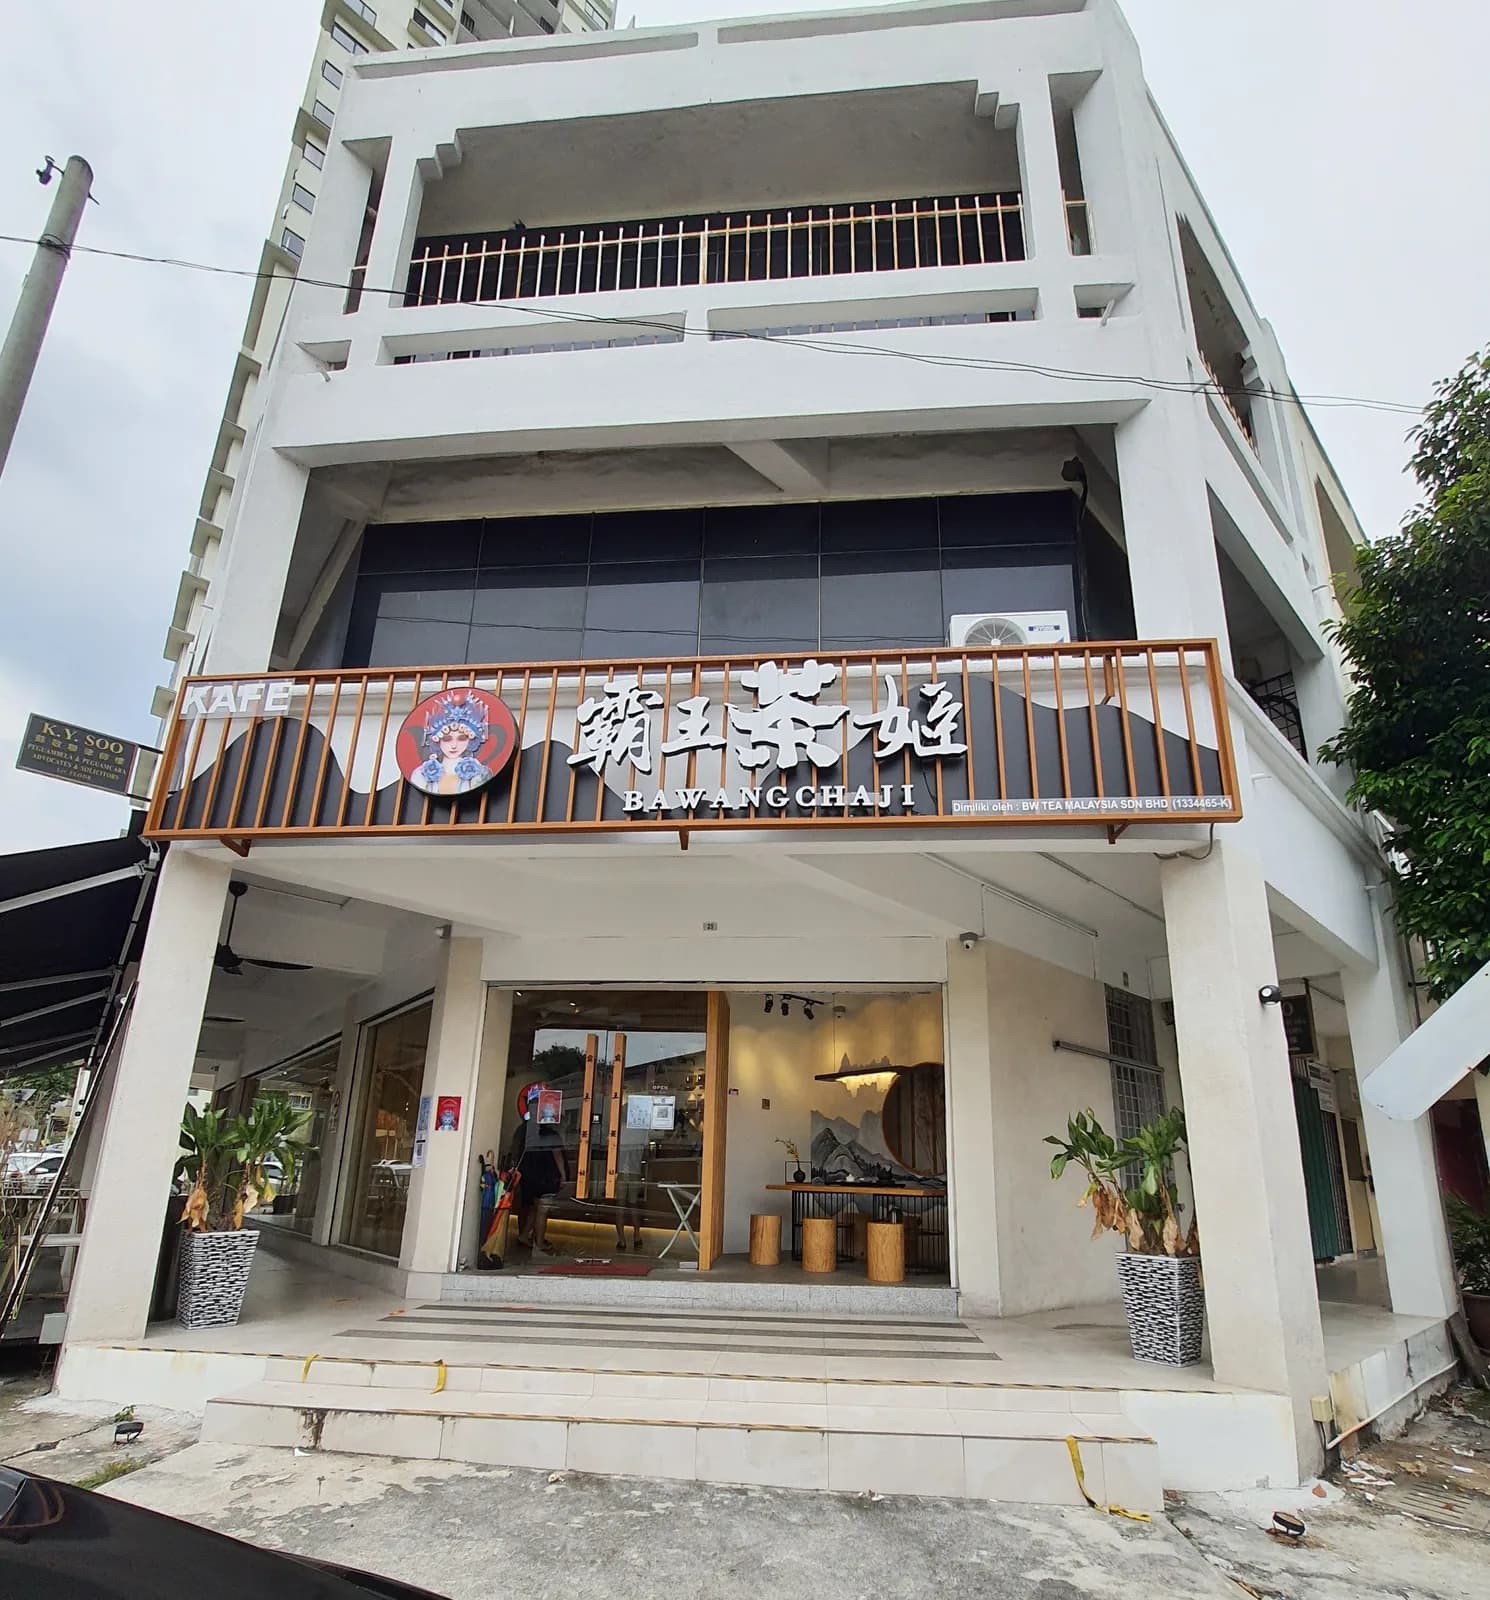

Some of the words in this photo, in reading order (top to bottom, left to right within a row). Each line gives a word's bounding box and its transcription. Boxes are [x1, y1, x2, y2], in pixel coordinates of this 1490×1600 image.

[181, 682, 291, 714] KAFE
[566, 658, 968, 773] 霸王茶姬
[42, 722, 78, 742] K.Y.
[84, 735, 124, 754] SOO
[623, 784, 915, 813] BAWANGCHAJI
[953, 802, 989, 812] Dimiliki
[992, 802, 1013, 812] oleh
[1022, 801, 1039, 811] BW
[1041, 800, 1062, 811] TEA
[1065, 799, 1118, 811] MALAYSIA
[1120, 799, 1143, 809] SDN
[1145, 798, 1168, 809] BHD
[1172, 797, 1232, 810] (1334465-K)
